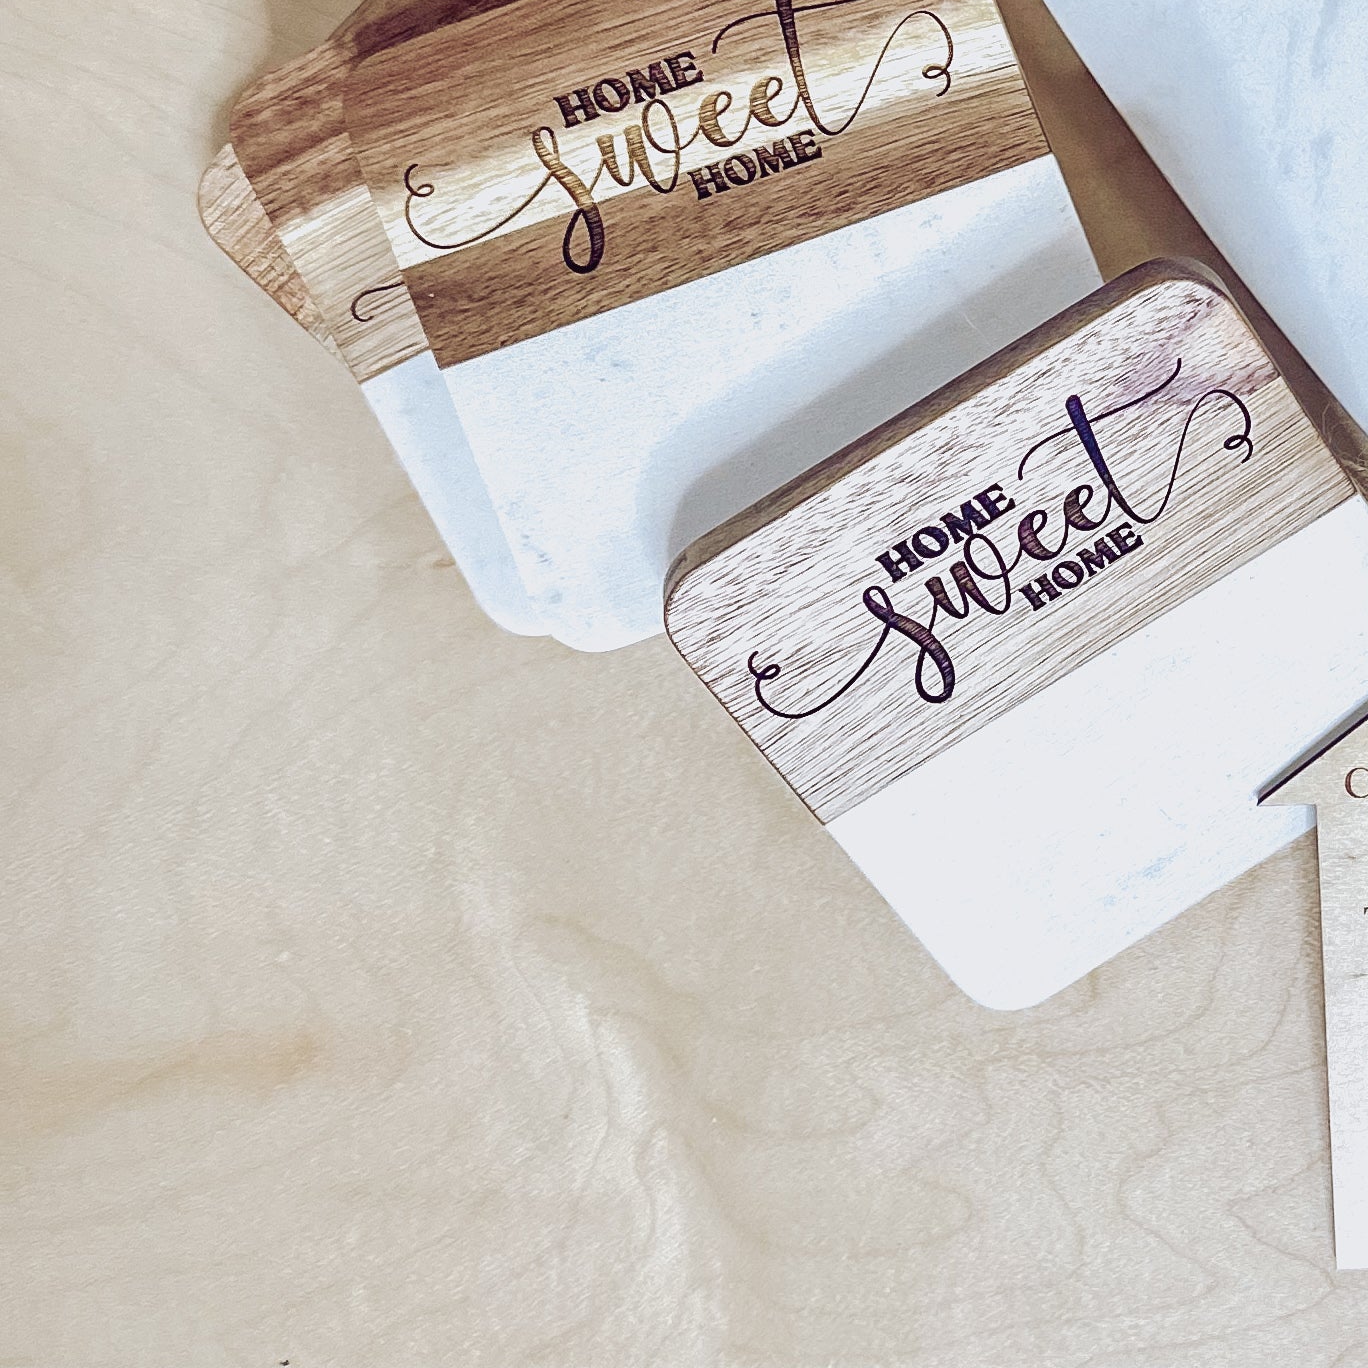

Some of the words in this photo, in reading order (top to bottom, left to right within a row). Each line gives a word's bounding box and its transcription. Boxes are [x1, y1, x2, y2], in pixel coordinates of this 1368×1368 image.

[553, 50, 705, 129] HOME
[686, 128, 823, 201] HOME
[748, 358, 1253, 719] sweet
[874, 482, 1015, 583] HOME
[1018, 522, 1144, 612] HOME
